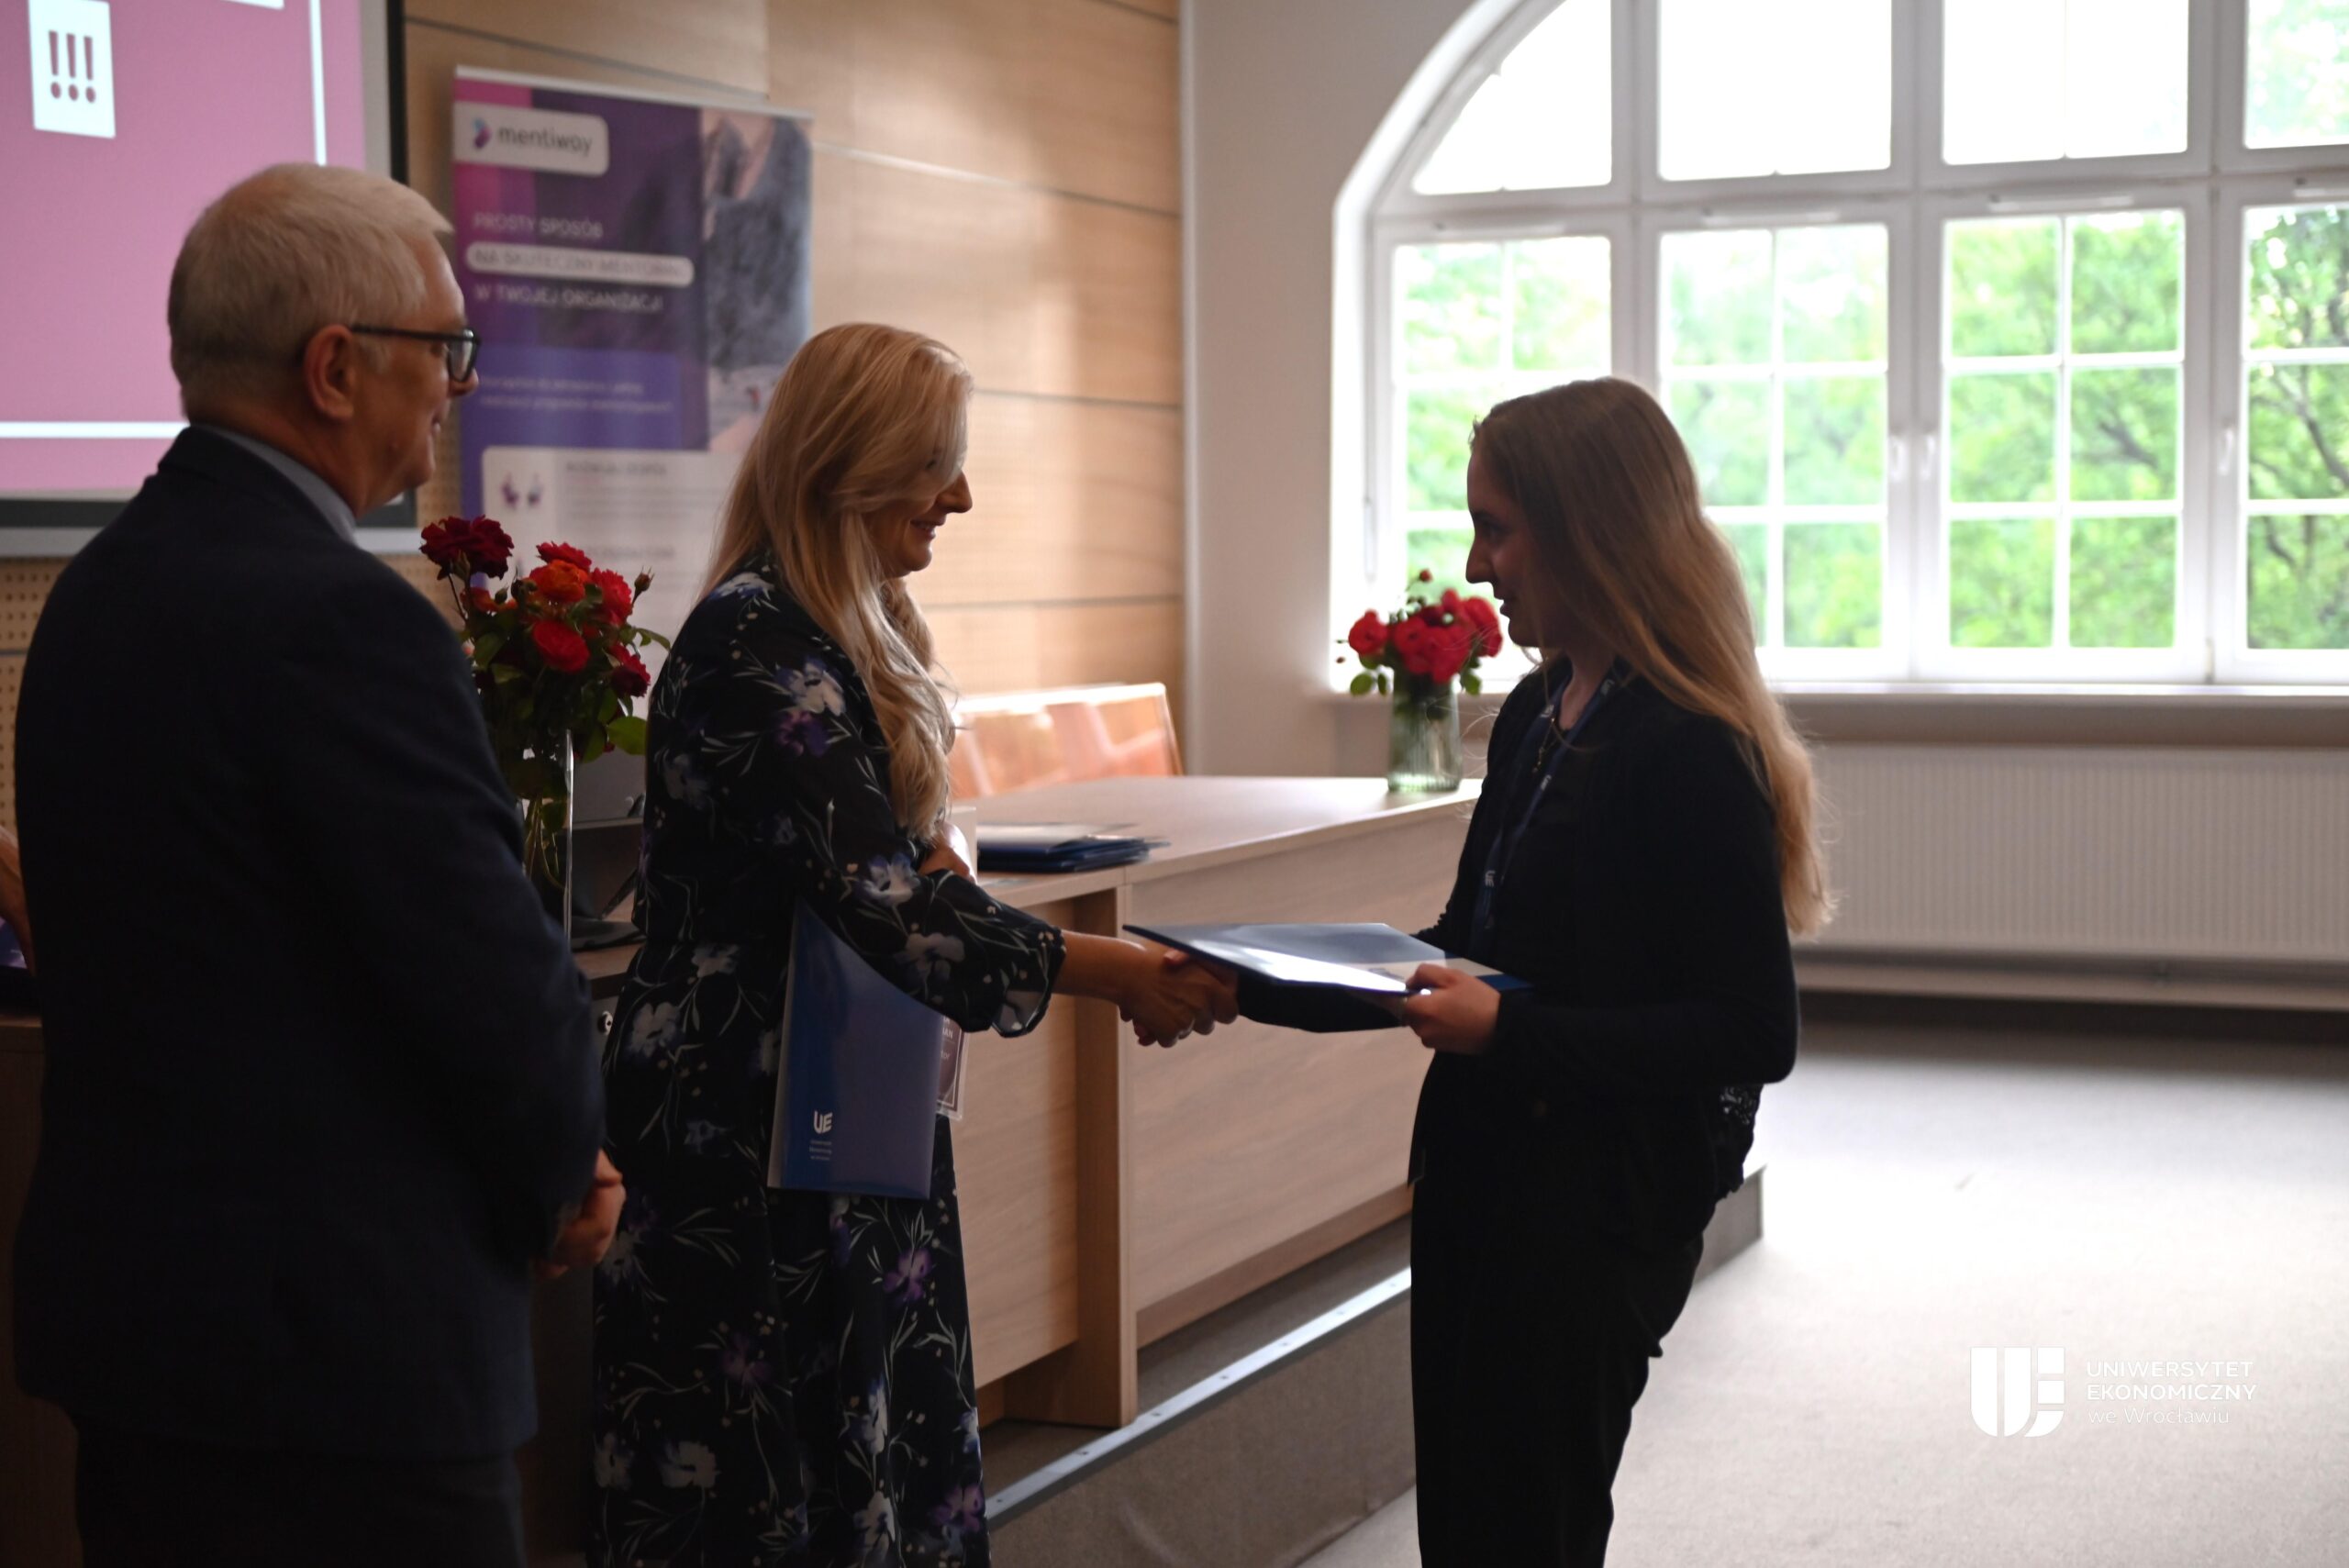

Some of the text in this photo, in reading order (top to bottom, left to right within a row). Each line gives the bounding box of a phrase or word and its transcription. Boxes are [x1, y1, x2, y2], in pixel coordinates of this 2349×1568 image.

[498, 125, 592, 157] mentiway
[540, 216, 603, 238] SPOSÓB
[474, 284, 491, 301] W
[813, 1110, 833, 1134] UE
